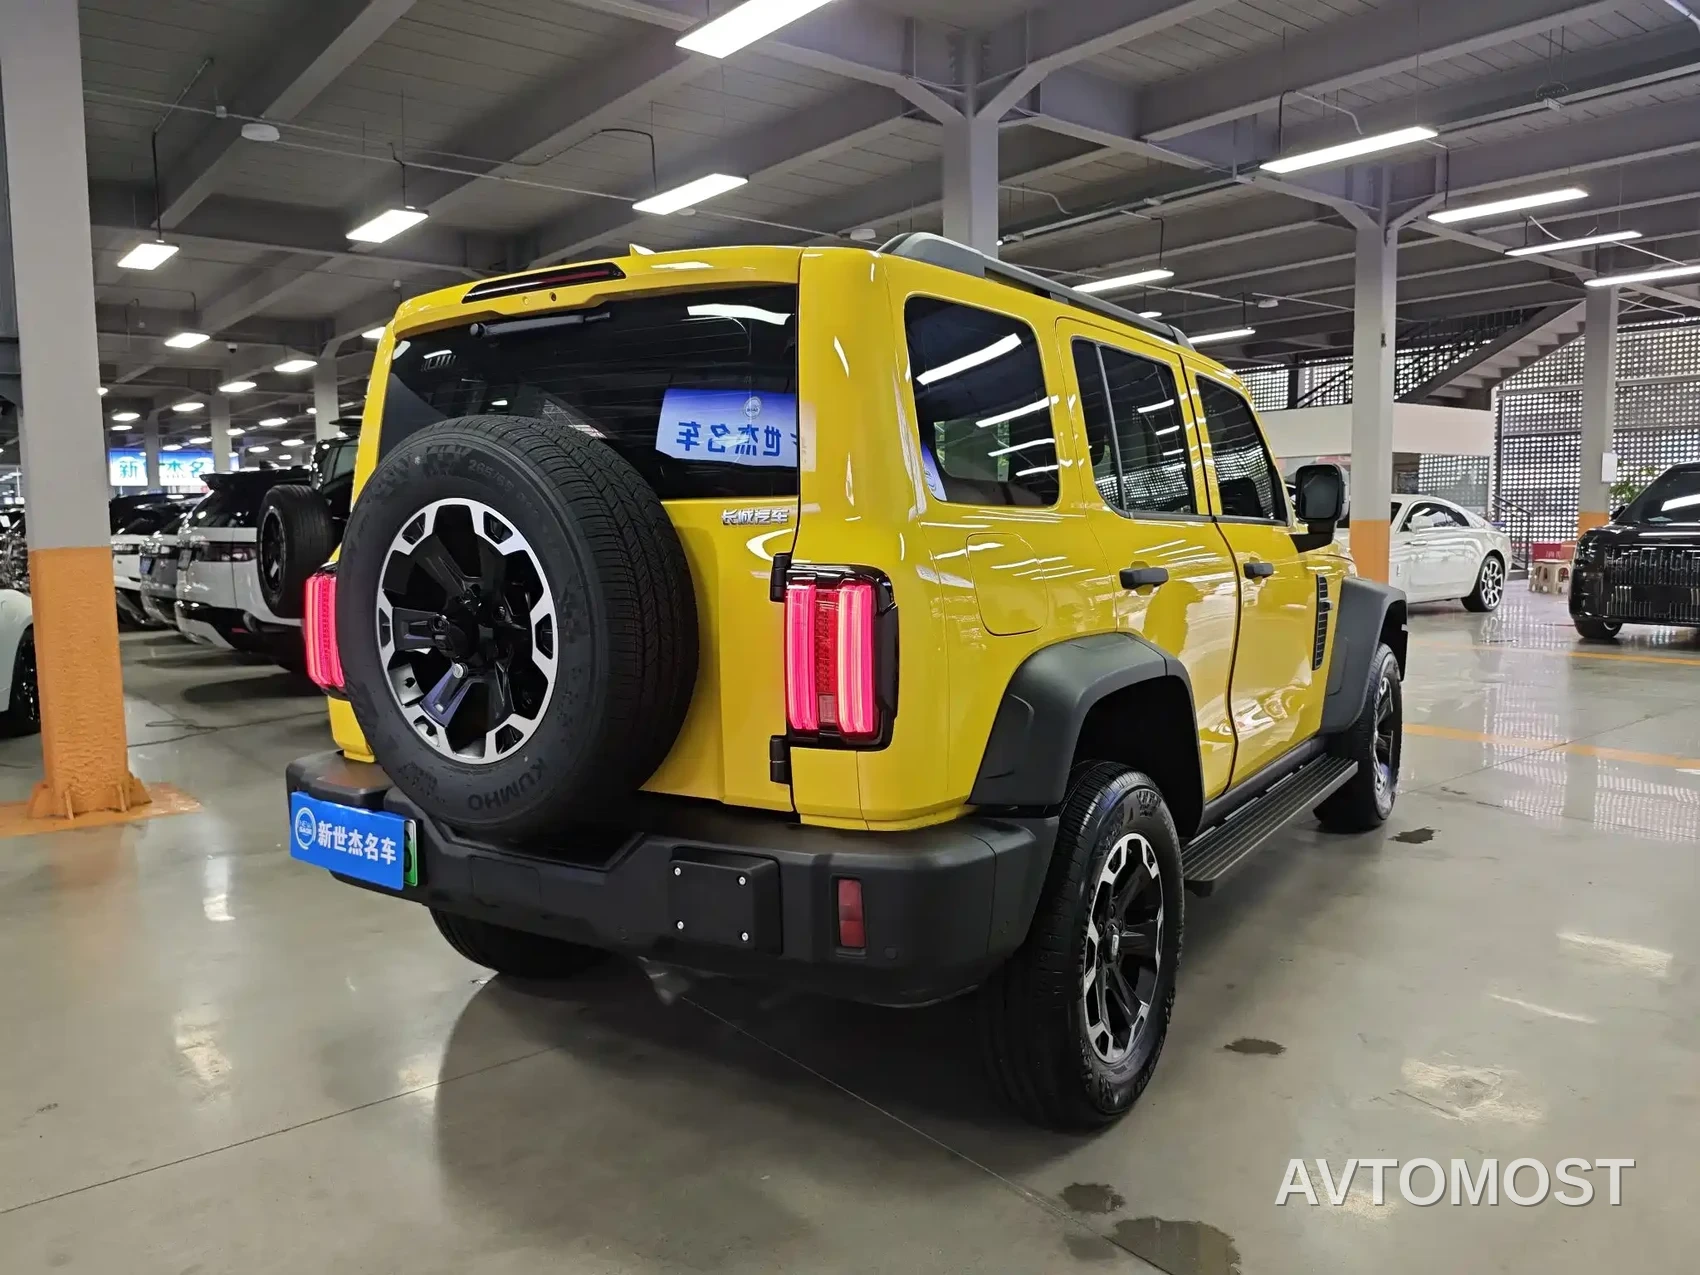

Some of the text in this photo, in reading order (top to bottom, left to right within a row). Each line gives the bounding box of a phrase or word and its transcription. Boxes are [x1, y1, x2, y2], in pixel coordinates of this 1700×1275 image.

[467, 757, 549, 811] KUMHO
[317, 820, 397, 865] 新世杰名车
